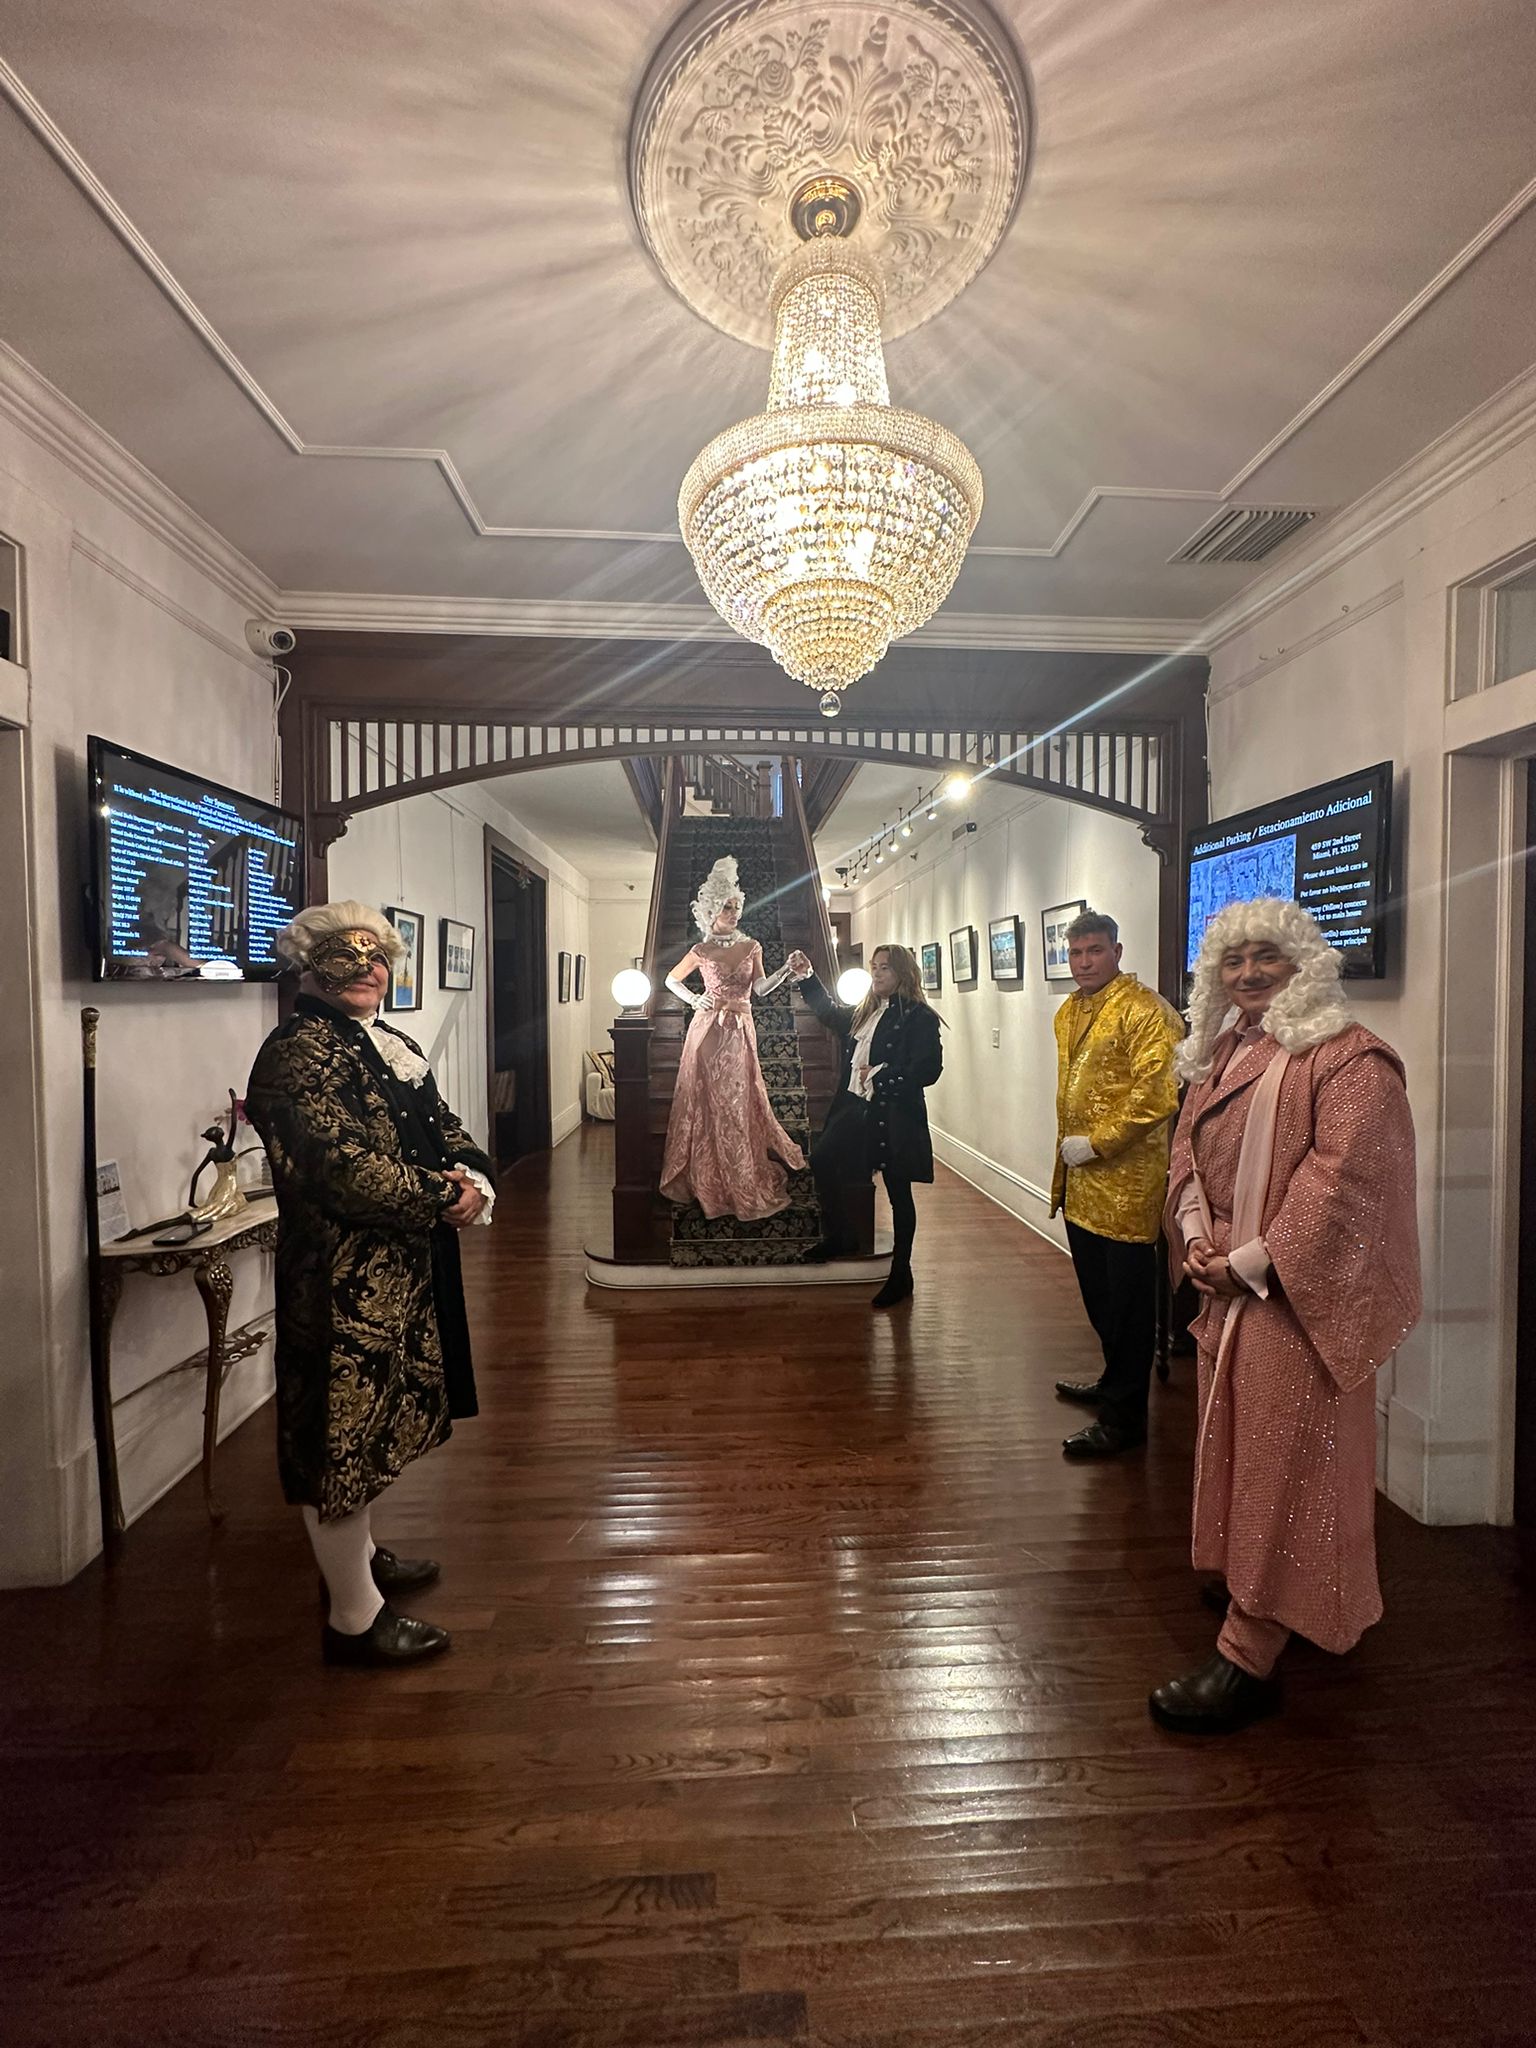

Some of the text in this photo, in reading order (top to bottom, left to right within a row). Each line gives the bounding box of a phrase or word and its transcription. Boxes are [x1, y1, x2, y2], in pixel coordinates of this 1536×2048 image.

[1193, 838, 1225, 856] Additional
[1226, 829, 1251, 847] Parking
[1258, 807, 1324, 837] Estacionamiento
[1326, 791, 1372, 817] Adicional
